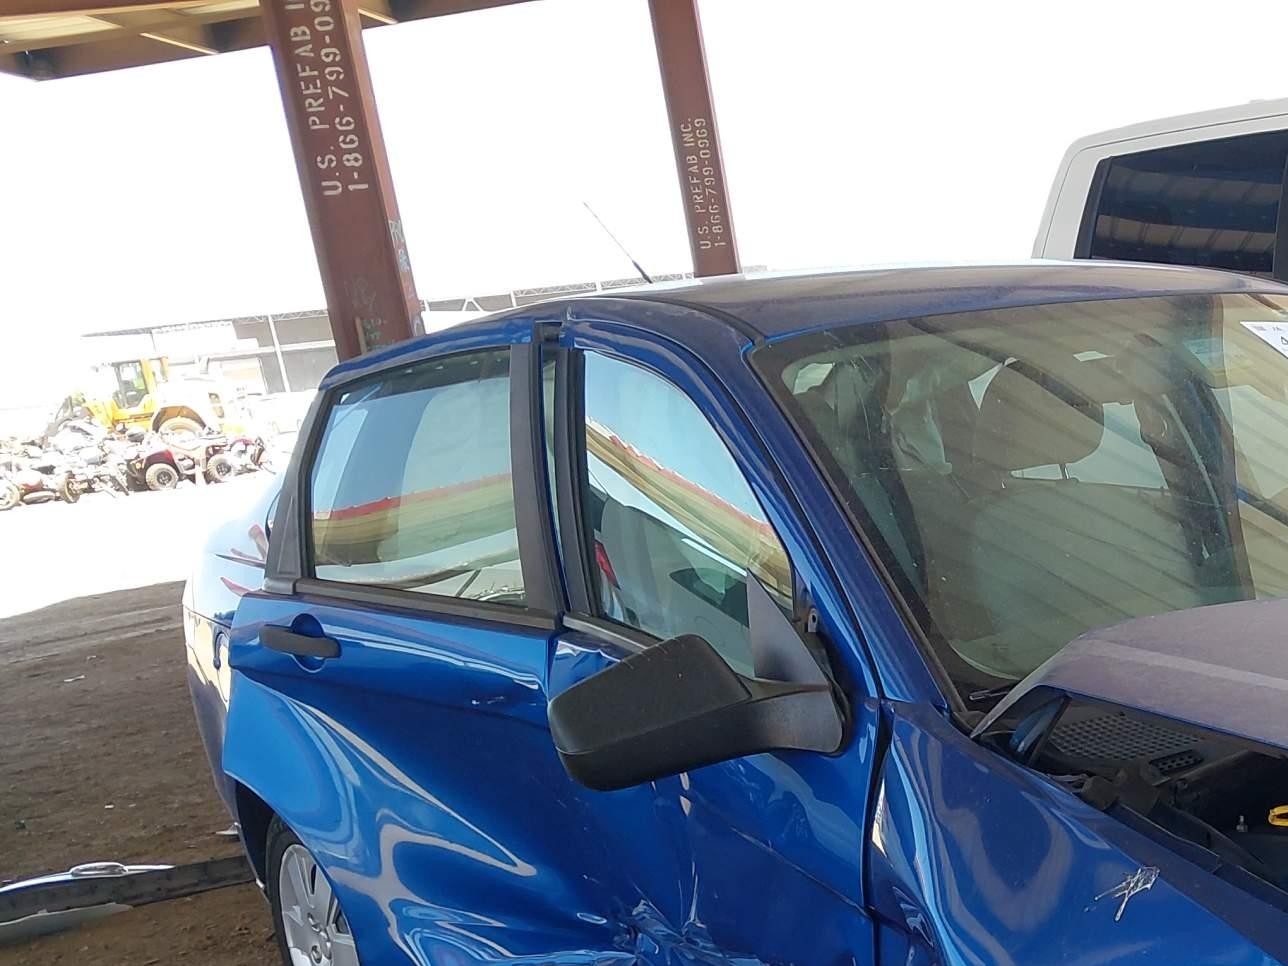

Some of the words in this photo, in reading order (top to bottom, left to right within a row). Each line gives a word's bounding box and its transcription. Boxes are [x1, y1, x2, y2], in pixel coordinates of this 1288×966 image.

[290, 26, 329, 129] PREFAB
[681, 118, 695, 147] INC.
[317, 146, 342, 195] U.S.
[686, 155, 706, 213] PREFAB
[694, 118, 726, 247] 1-866-799-0969
[698, 220, 712, 249] U.S.
